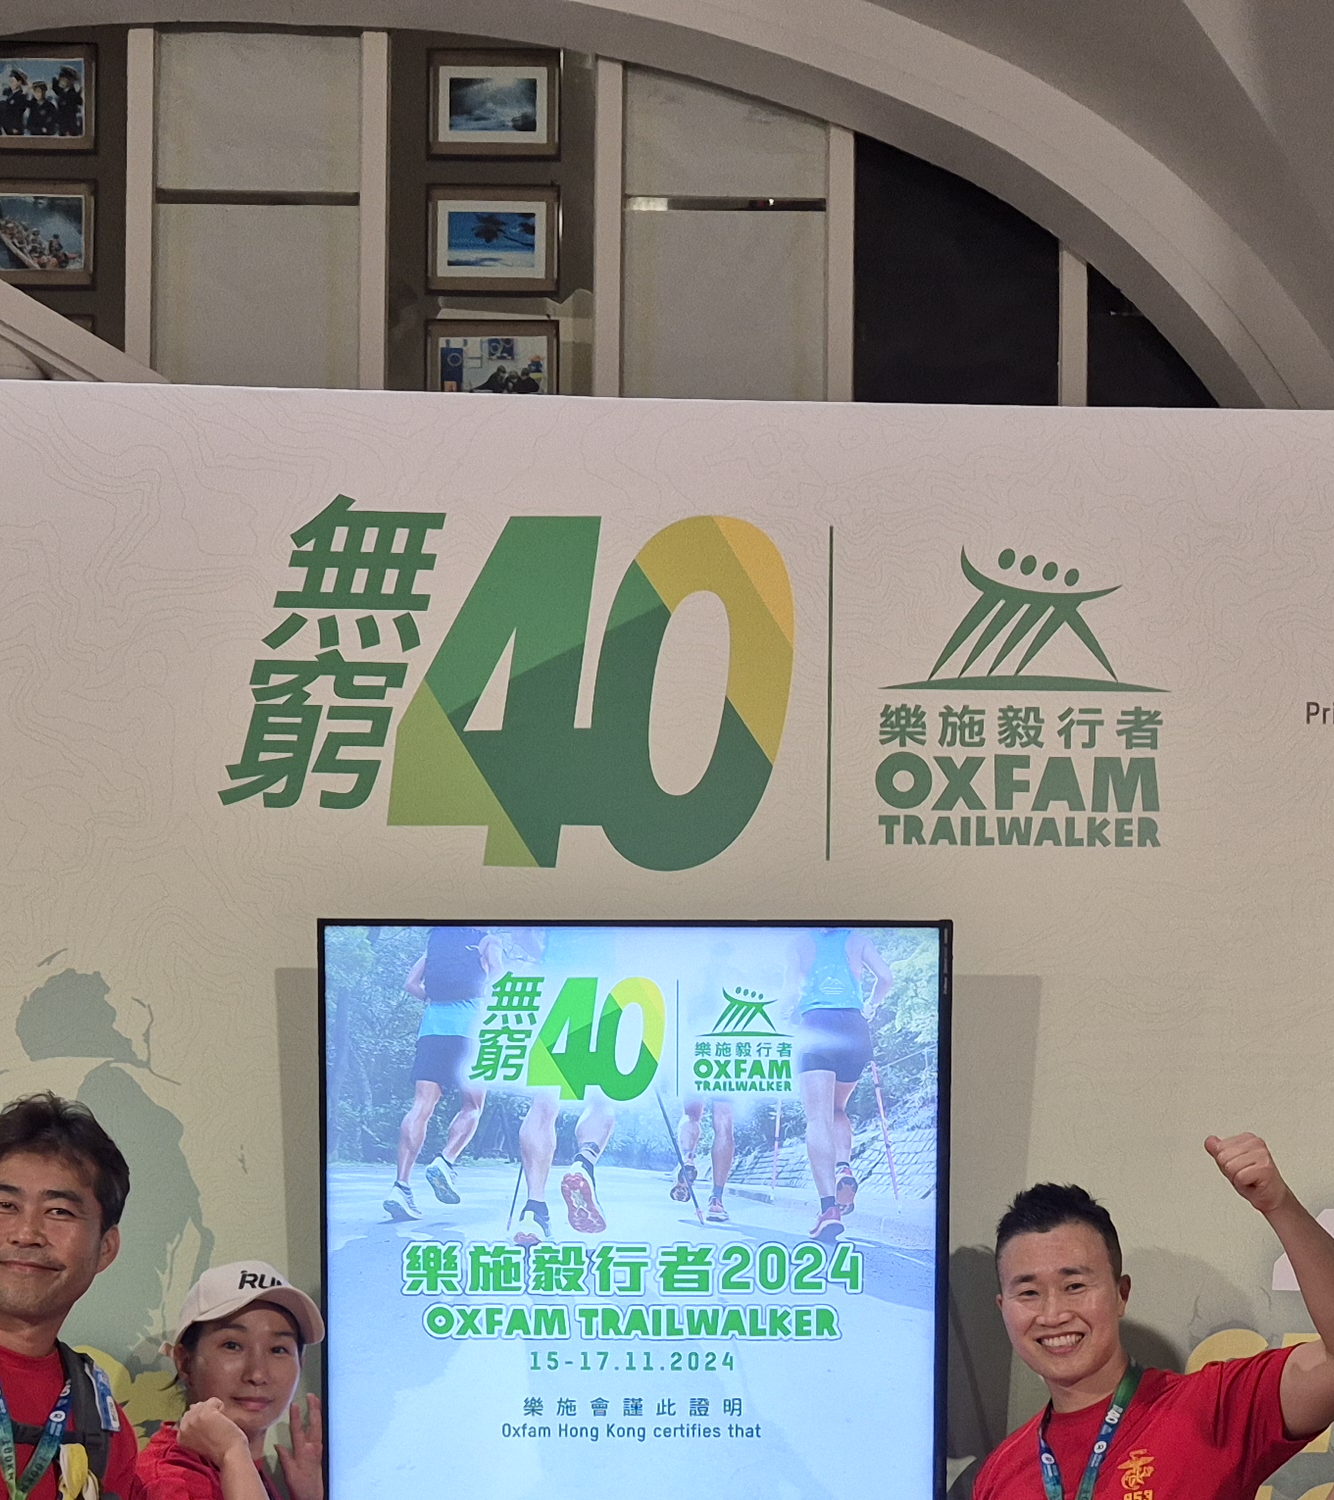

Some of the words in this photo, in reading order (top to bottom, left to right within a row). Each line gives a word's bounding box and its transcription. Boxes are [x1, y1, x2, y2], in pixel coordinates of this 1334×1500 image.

[217, 493, 447, 810] 無窮
[386, 514, 795, 872] 40
[877, 703, 1163, 751] 樂施毅行者
[874, 753, 1160, 813] OXFAM
[878, 815, 1161, 848] TRAILWALKER
[468, 971, 545, 1082] 無窮
[526, 976, 665, 1101] 40
[694, 1041, 793, 1057] 樂施毅行者
[693, 1059, 792, 1079] OXFAM
[694, 1080, 793, 1092] TRAILWALKER
[404, 1243, 862, 1293] 樂施毅行者2024
[426, 1306, 567, 1336] OXFAM
[577, 1307, 838, 1337] TRAILWALKER
[529, 1351, 735, 1371] 15-17.11.2024
[523, 1397, 744, 1417] 樂施會謹此證明
[501, 1423, 551, 1438] Oxfam
[559, 1423, 599, 1442] Hong
[606, 1423, 646, 1442] Kong
[653, 1423, 721, 1438] certifies
[728, 1423, 762, 1438] that
